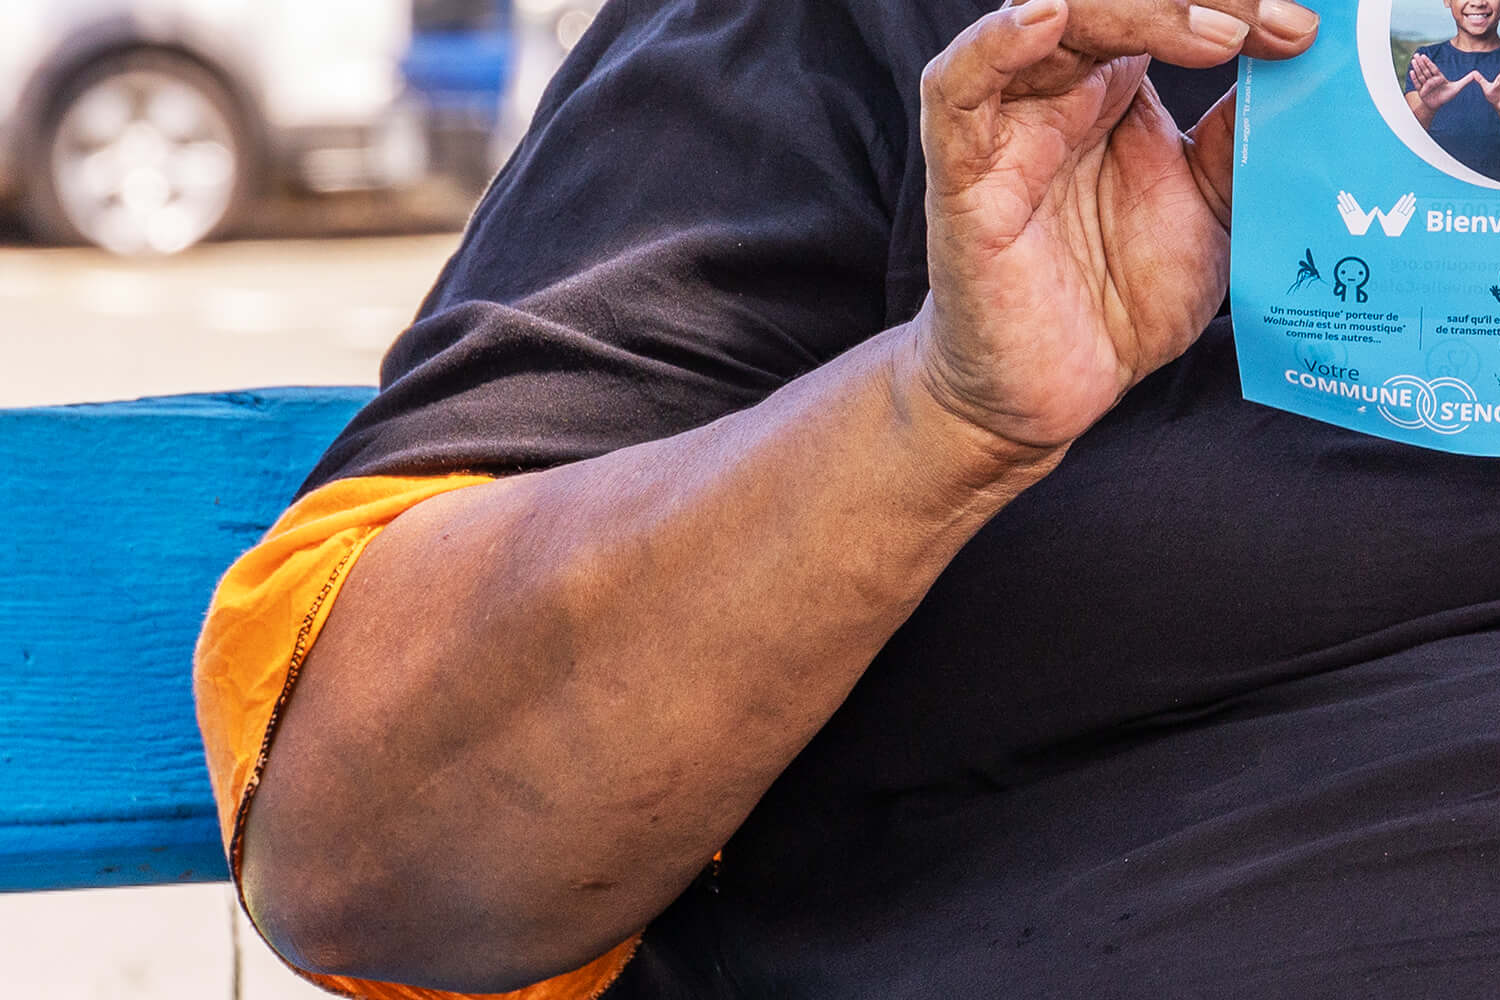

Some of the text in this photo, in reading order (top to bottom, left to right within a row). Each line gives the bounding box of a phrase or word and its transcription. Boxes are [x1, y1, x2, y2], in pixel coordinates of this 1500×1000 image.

[1270, 306, 1284, 314] Un
[1346, 311, 1384, 321] porteur
[1386, 312, 1399, 321] de
[1447, 315, 1469, 323] sauf
[1470, 315, 1492, 326] qu'il
[1263, 316, 1314, 328] Wolbachia
[1316, 321, 1331, 329] est
[1334, 322, 1346, 330] un
[1286, 330, 1323, 340] comme
[1325, 332, 1339, 341] les
[1435, 326, 1448, 335] de
[1304, 358, 1360, 381] Votre
[1284, 369, 1413, 408] COMMUNE
